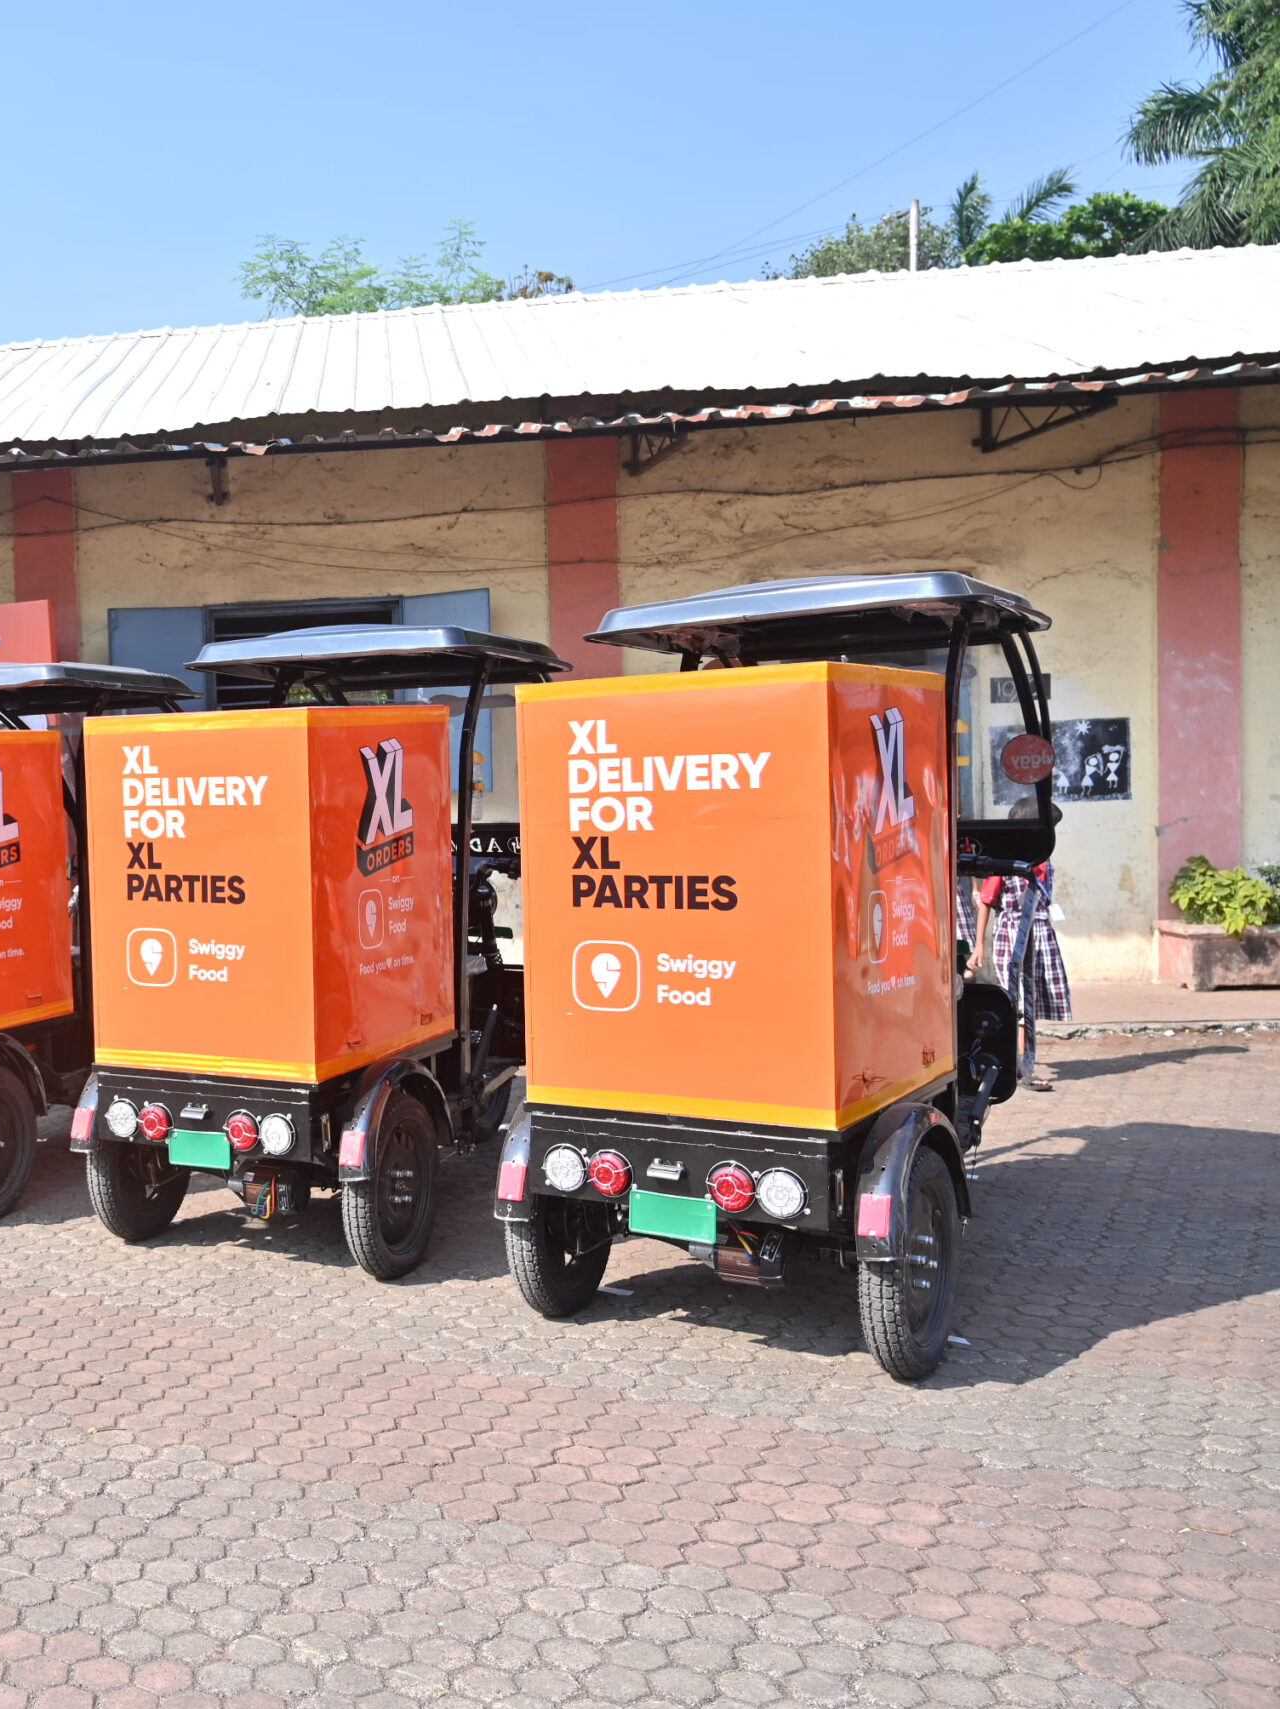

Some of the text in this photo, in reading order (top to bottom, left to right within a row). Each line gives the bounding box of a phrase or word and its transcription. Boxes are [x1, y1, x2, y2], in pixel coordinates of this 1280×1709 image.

[568, 720, 617, 754] XL
[122, 746, 158, 774] XL
[568, 752, 771, 793] DELIVERY
[870, 707, 914, 835] XL
[122, 776, 268, 807] DELIVERY
[359, 738, 413, 845] XL
[124, 809, 186, 838] FOR
[570, 796, 654, 831] FOR
[127, 842, 162, 870] XL
[366, 837, 412, 871] ORDERS
[572, 836, 620, 869] XL
[127, 874, 246, 904] PARTIES
[392, 875, 400, 883] on
[572, 874, 738, 911] PARTIES
[388, 896, 414, 912] Swiggy
[892, 902, 915, 921] Swiggy
[389, 919, 406, 934] Food
[892, 931, 908, 946] Food
[7, 947, 24, 958] time.
[188, 939, 245, 960] Swiggy
[189, 965, 228, 982] Food
[360, 954, 416, 975] Food you on time.
[657, 954, 737, 979] Swiggy
[657, 985, 711, 1006] Food
[868, 979, 880, 995] Food
